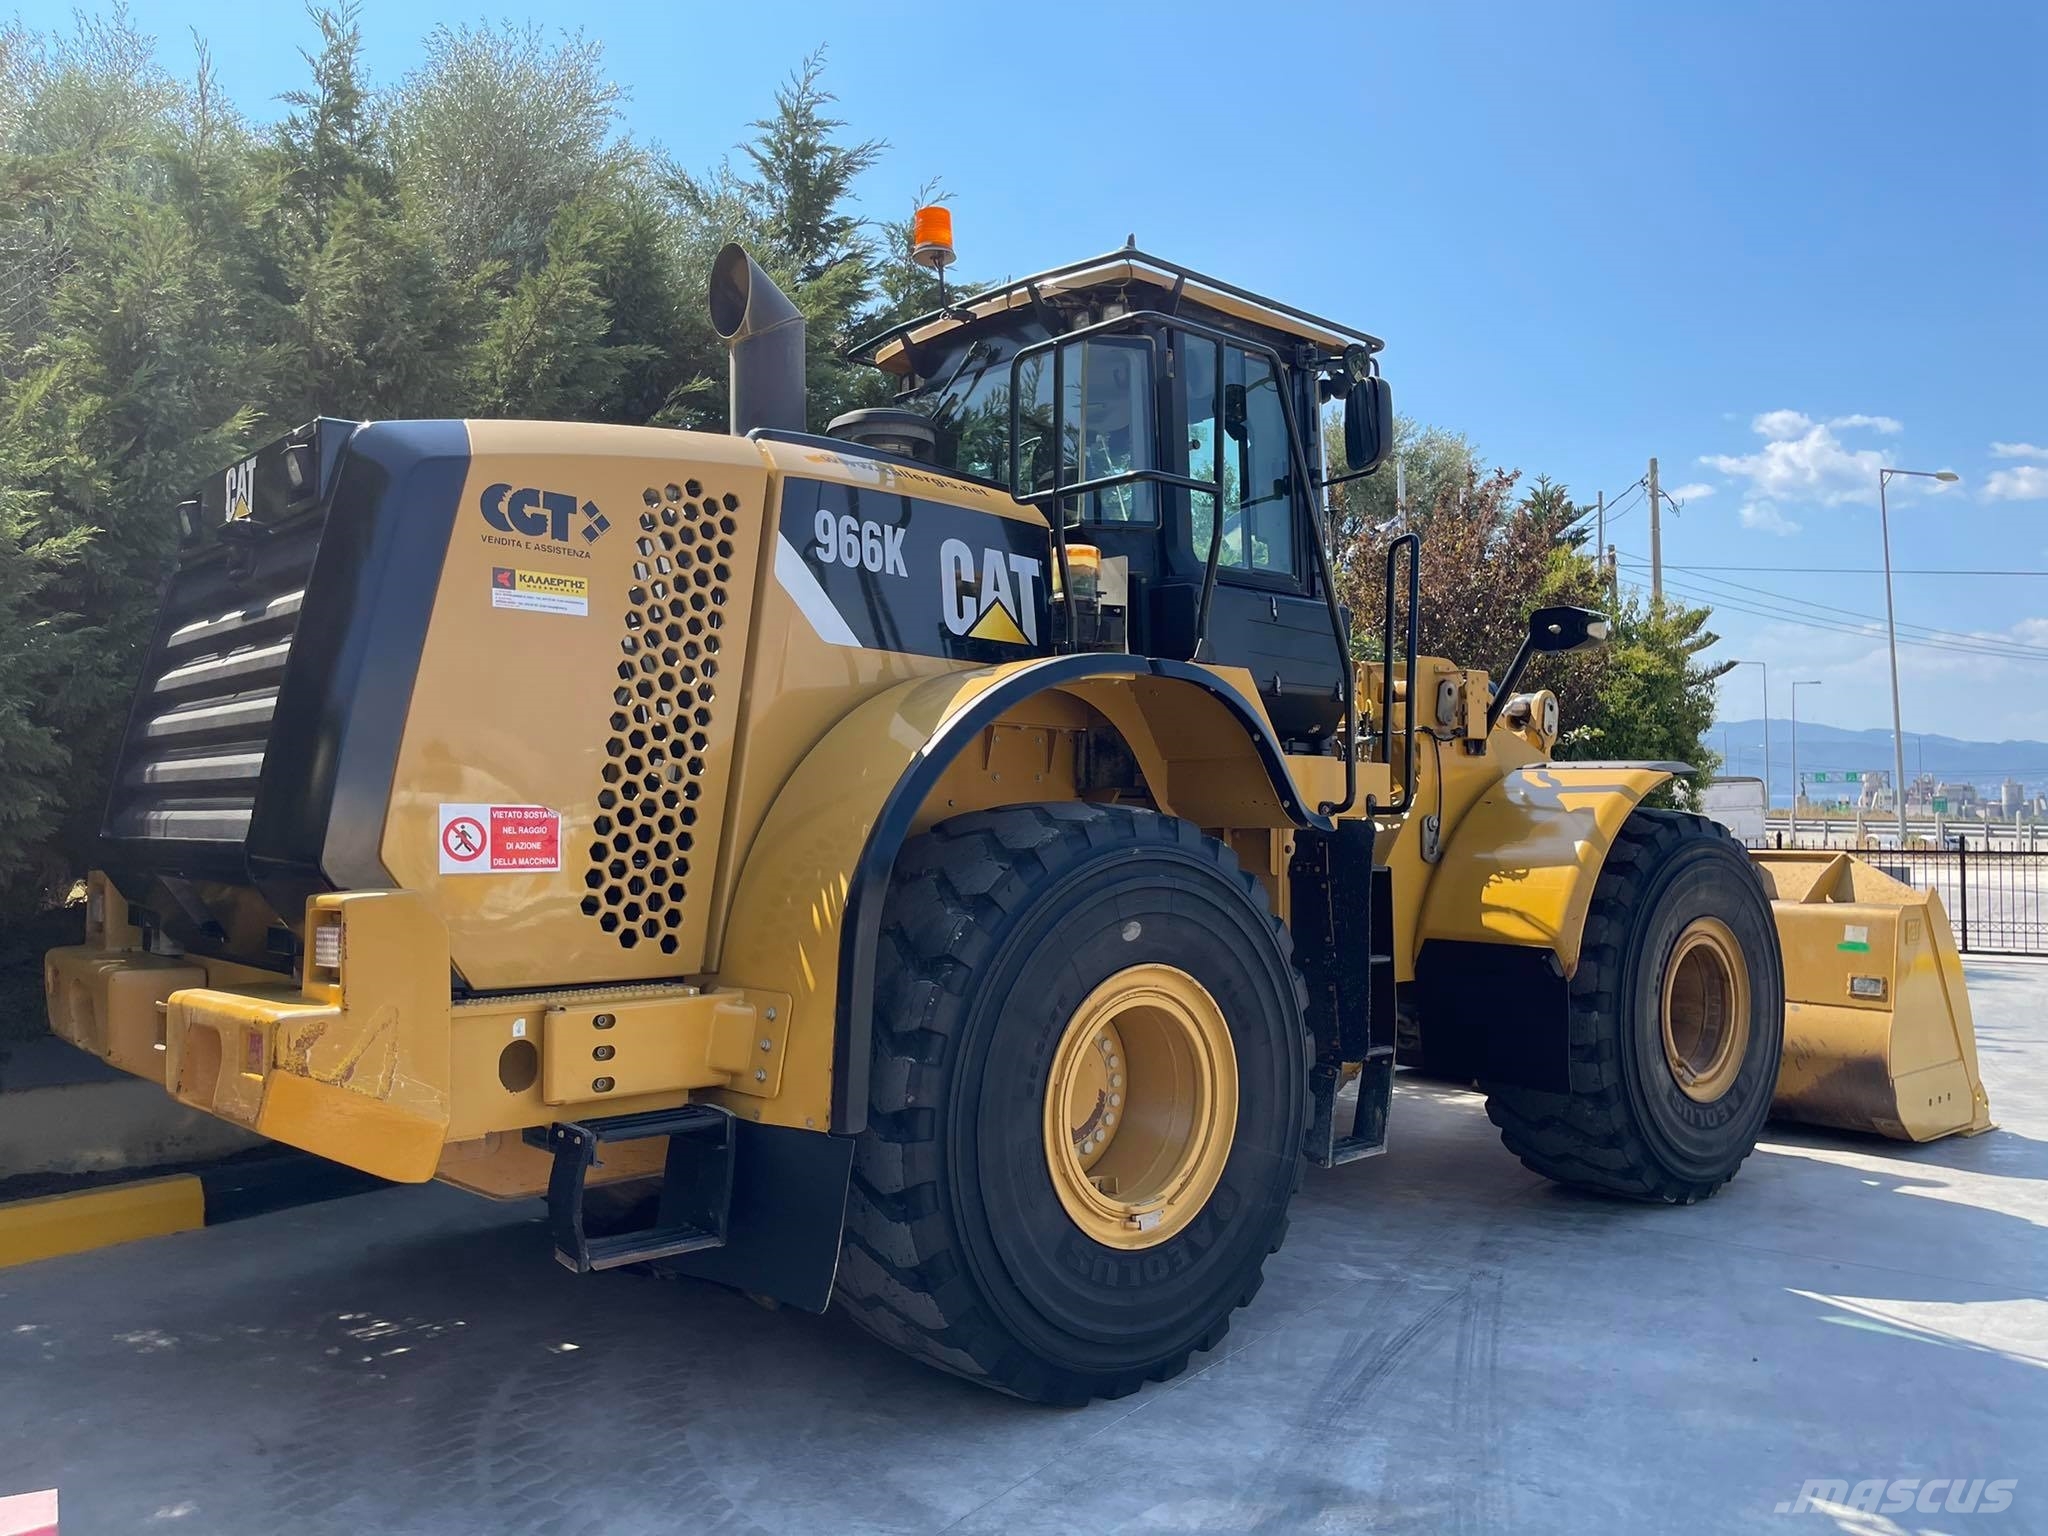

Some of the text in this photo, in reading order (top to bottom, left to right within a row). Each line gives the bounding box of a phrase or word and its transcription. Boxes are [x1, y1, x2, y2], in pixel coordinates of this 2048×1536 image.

[225, 455, 257, 522] CAT
[480, 483, 577, 542] CGT
[481, 534, 592, 559] VENDITA E ASSISTENZA
[814, 509, 909, 578] 966K
[519, 574, 585, 589] ΚΑΛΛΕΡΓΗΣ
[940, 538, 1040, 646] CAT
[492, 810, 522, 819] VIETATO
[502, 826, 548, 835] NEL RAGGIO
[506, 841, 542, 850] DI AZIONE
[493, 857, 557, 866] DELLA MACCHINA
